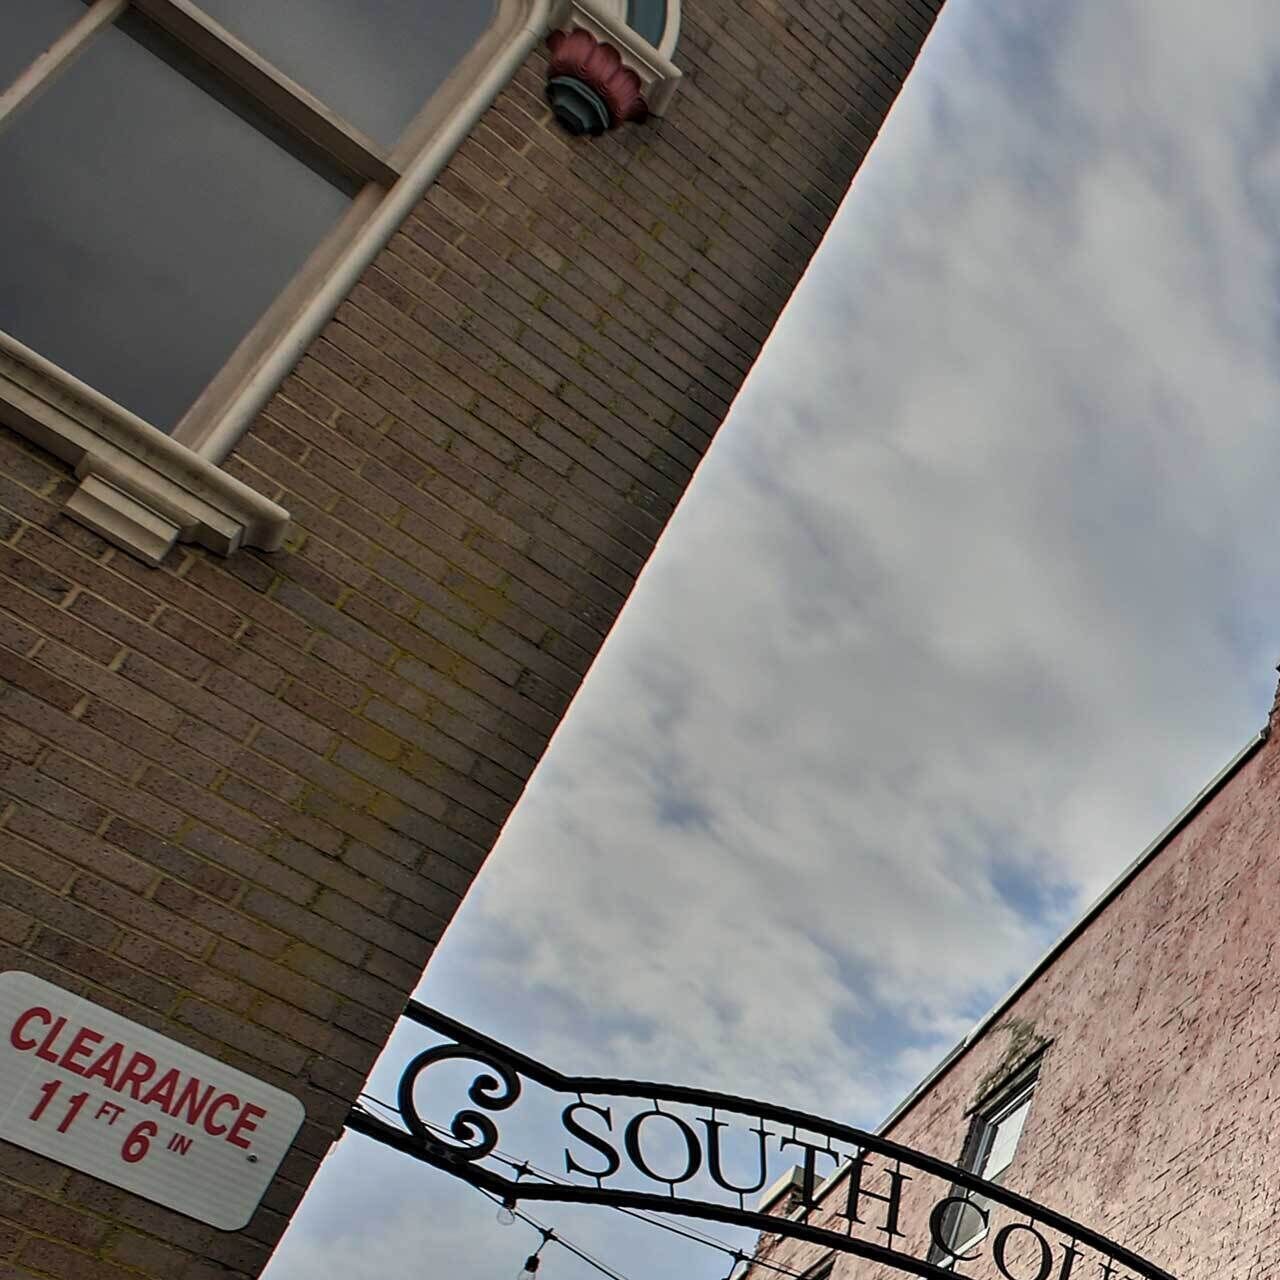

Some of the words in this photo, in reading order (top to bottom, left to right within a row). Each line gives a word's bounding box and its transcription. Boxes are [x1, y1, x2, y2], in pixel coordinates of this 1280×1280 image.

[10, 1006, 267, 1150] CLEARANCE
[28, 1079, 90, 1134] 11
[95, 1101, 126, 1126] FT
[121, 1120, 158, 1163] 6
[166, 1132, 194, 1156] IN
[562, 1102, 912, 1239] SOUTH
